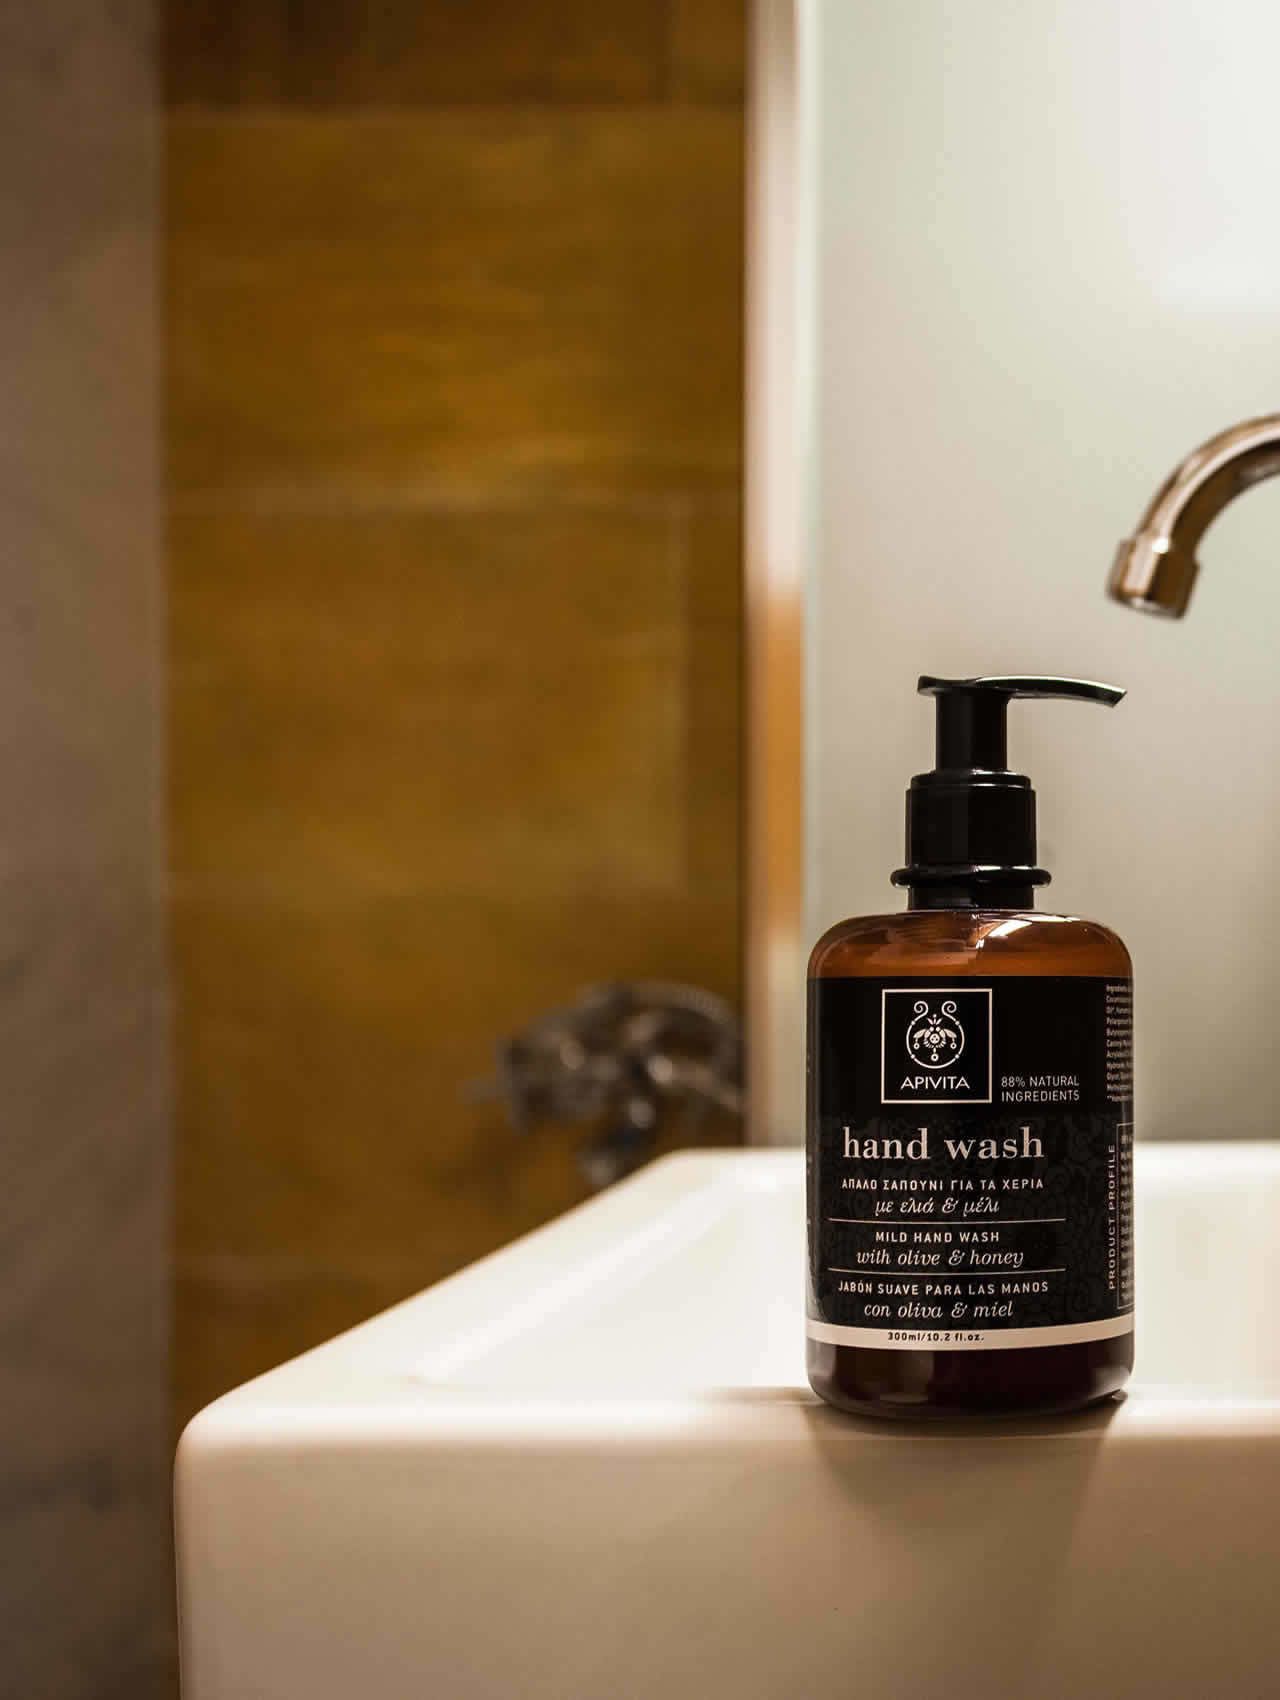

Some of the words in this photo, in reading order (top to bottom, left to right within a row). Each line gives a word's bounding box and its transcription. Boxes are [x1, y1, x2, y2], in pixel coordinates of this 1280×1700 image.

[900, 1076, 970, 1089] APIVITA
[1001, 1076, 1026, 1088] 88%
[1029, 1075, 1080, 1087] NATURAL
[1001, 1089, 1080, 1102] INGREDIENTS
[842, 1126, 931, 1160] hand
[944, 1126, 1045, 1160] wash
[841, 1178, 878, 1190] ΑΠΑΛΟ
[883, 1179, 944, 1191] ΣΑΠΟΥΝΙ
[951, 1179, 974, 1191] ΓΙΑ
[980, 1179, 996, 1191] ΤΑ
[1002, 1178, 1044, 1190] ΧΕΡΙΑ
[1107, 1144, 1116, 1211] PROFILE
[875, 1200, 894, 1217] με
[900, 1197, 934, 1214] ελιά
[941, 1198, 958, 1214] &
[963, 1198, 1000, 1217] μέλι
[875, 1231, 907, 1243] MILD
[914, 1231, 953, 1243] HAND
[959, 1231, 1000, 1243] WASH
[856, 1248, 891, 1265] with
[897, 1249, 940, 1266] olive
[948, 1249, 965, 1265] &
[970, 1249, 1024, 1268] honey
[1107, 1217, 1116, 1290] PRODUCT
[838, 1279, 873, 1294] JABÓN
[877, 1283, 919, 1296] SUAVE
[925, 1284, 962, 1296] PARA
[968, 1283, 996, 1295] LAS
[1001, 1280, 1049, 1295] MANOS
[864, 1303, 892, 1318] con
[897, 1301, 943, 1319] oliva
[951, 1301, 968, 1318] &
[973, 1300, 1014, 1318] miel
